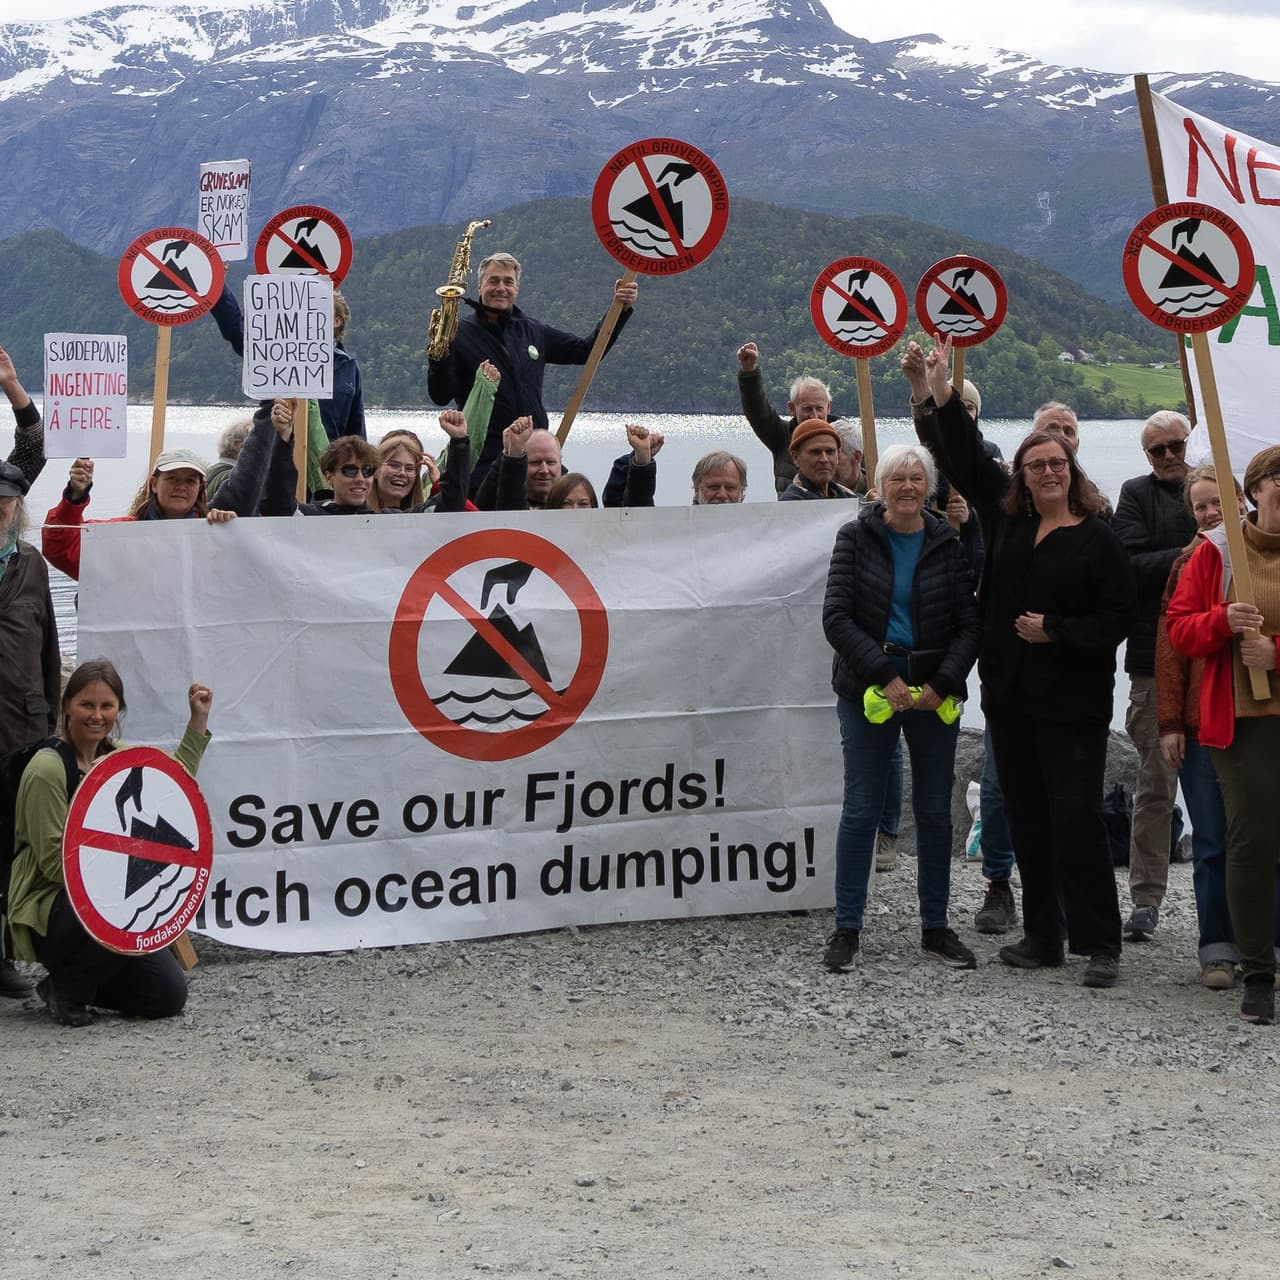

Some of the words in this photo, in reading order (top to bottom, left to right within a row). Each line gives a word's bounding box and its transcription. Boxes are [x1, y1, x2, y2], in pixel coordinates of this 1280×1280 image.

[200, 171, 249, 192] GRUVESLAM
[610, 155, 628, 173] NEI
[631, 146, 649, 158] TIL
[652, 141, 726, 211] GRUVEDUMPING
[201, 196, 214, 212] ER
[203, 212, 243, 243] SKAM
[1156, 205, 1238, 236] GRUVEAVFALL
[154, 228, 217, 258] GRUVEAVFALL
[603, 231, 695, 272] FØRDEFJORDEN
[251, 280, 328, 311] GRUVE-
[1158, 291, 1247, 330] FØRDEFJORDEN
[252, 312, 299, 342] SLAM
[306, 311, 326, 341] ER
[49, 340, 126, 363] SJØDEPONI?
[252, 341, 330, 363] NOREGS
[50, 372, 127, 397] INGENTING
[252, 364, 325, 388] SKAM
[50, 400, 60, 431] Å
[225, 793, 380, 848] Save
[402, 787, 505, 833] our
[524, 758, 726, 833] Fjords!
[333, 860, 517, 917] ocean
[539, 826, 817, 899] dumping!
[136, 867, 209, 951] fjordaksjonen.org
